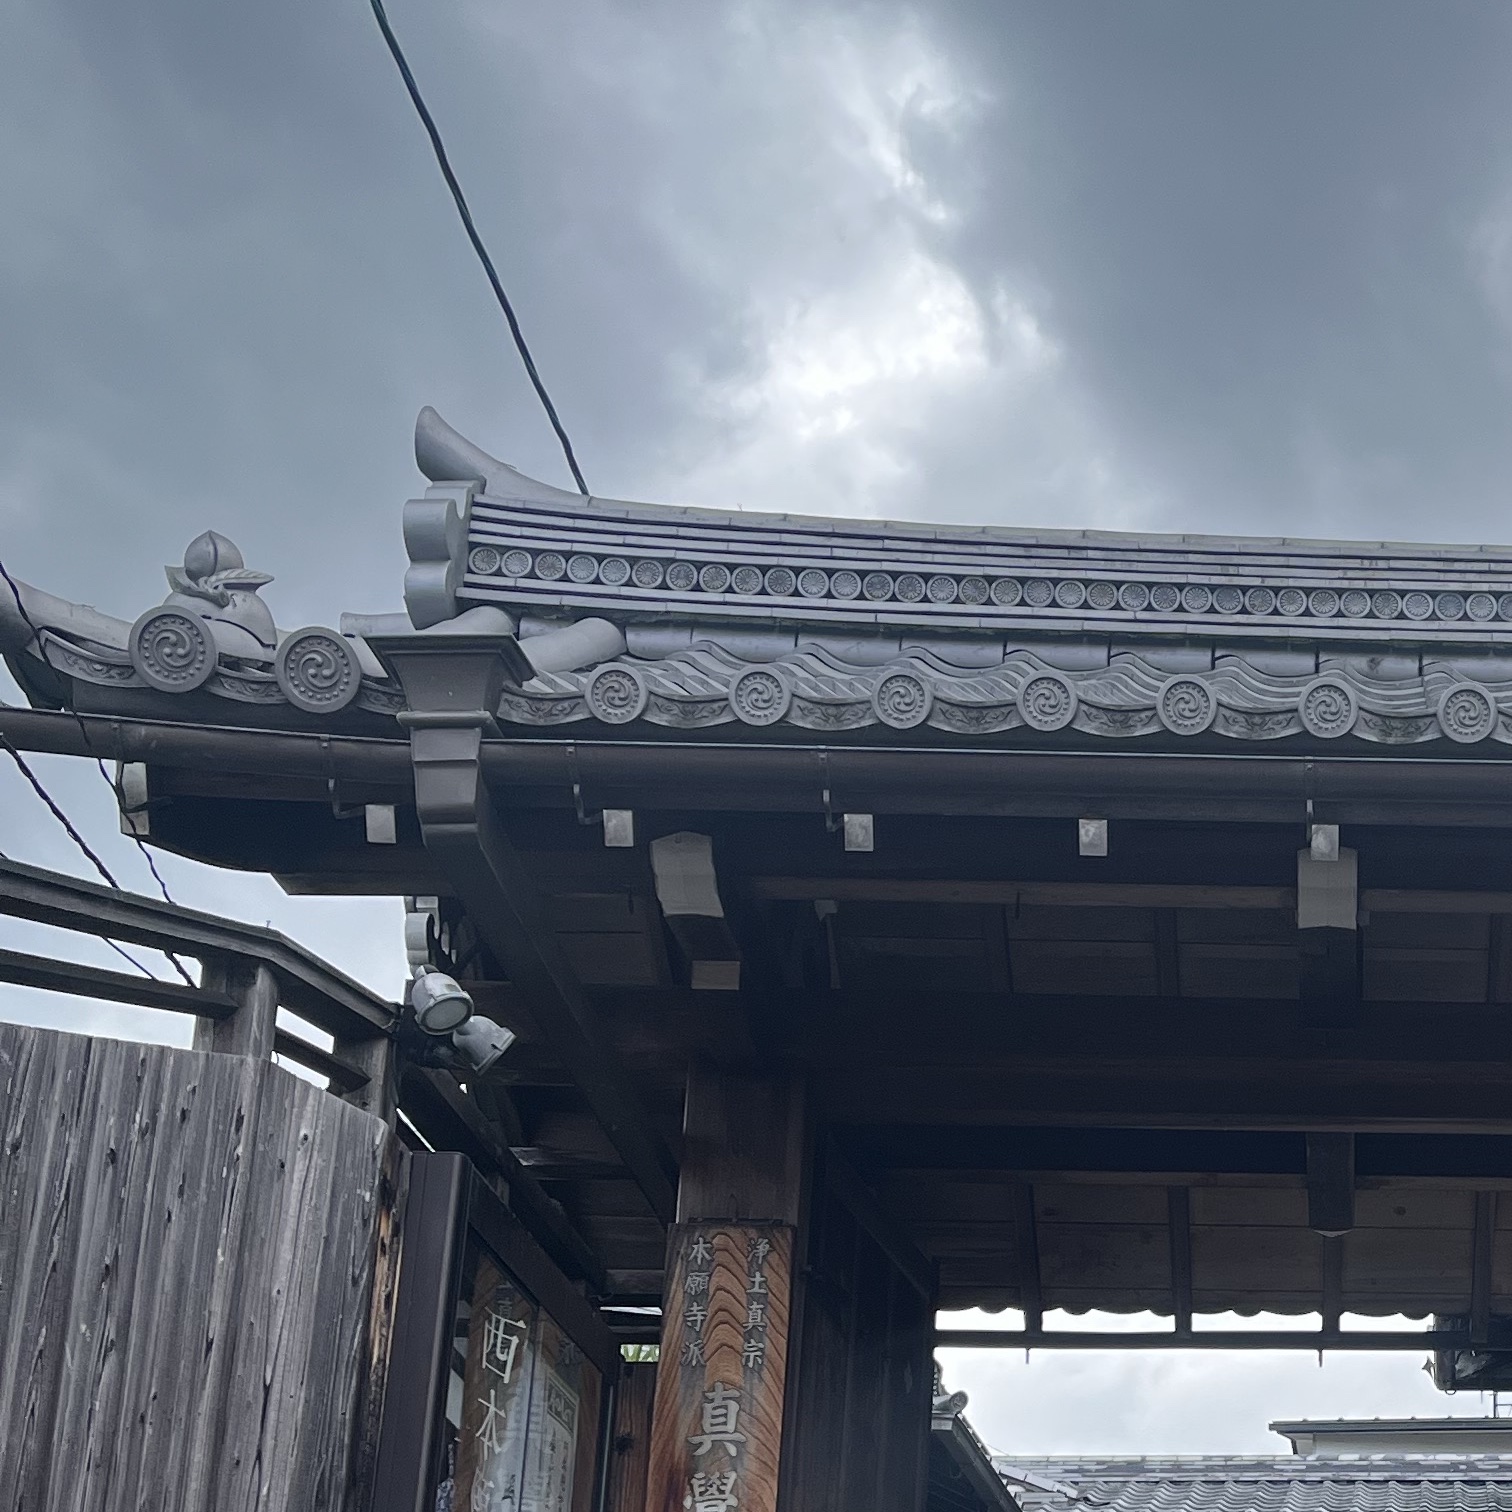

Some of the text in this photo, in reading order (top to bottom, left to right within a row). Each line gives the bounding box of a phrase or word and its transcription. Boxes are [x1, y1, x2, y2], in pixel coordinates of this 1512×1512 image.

[680, 1237, 713, 1367] 本願寺派
[742, 1237, 773, 1368] 浄土真宗
